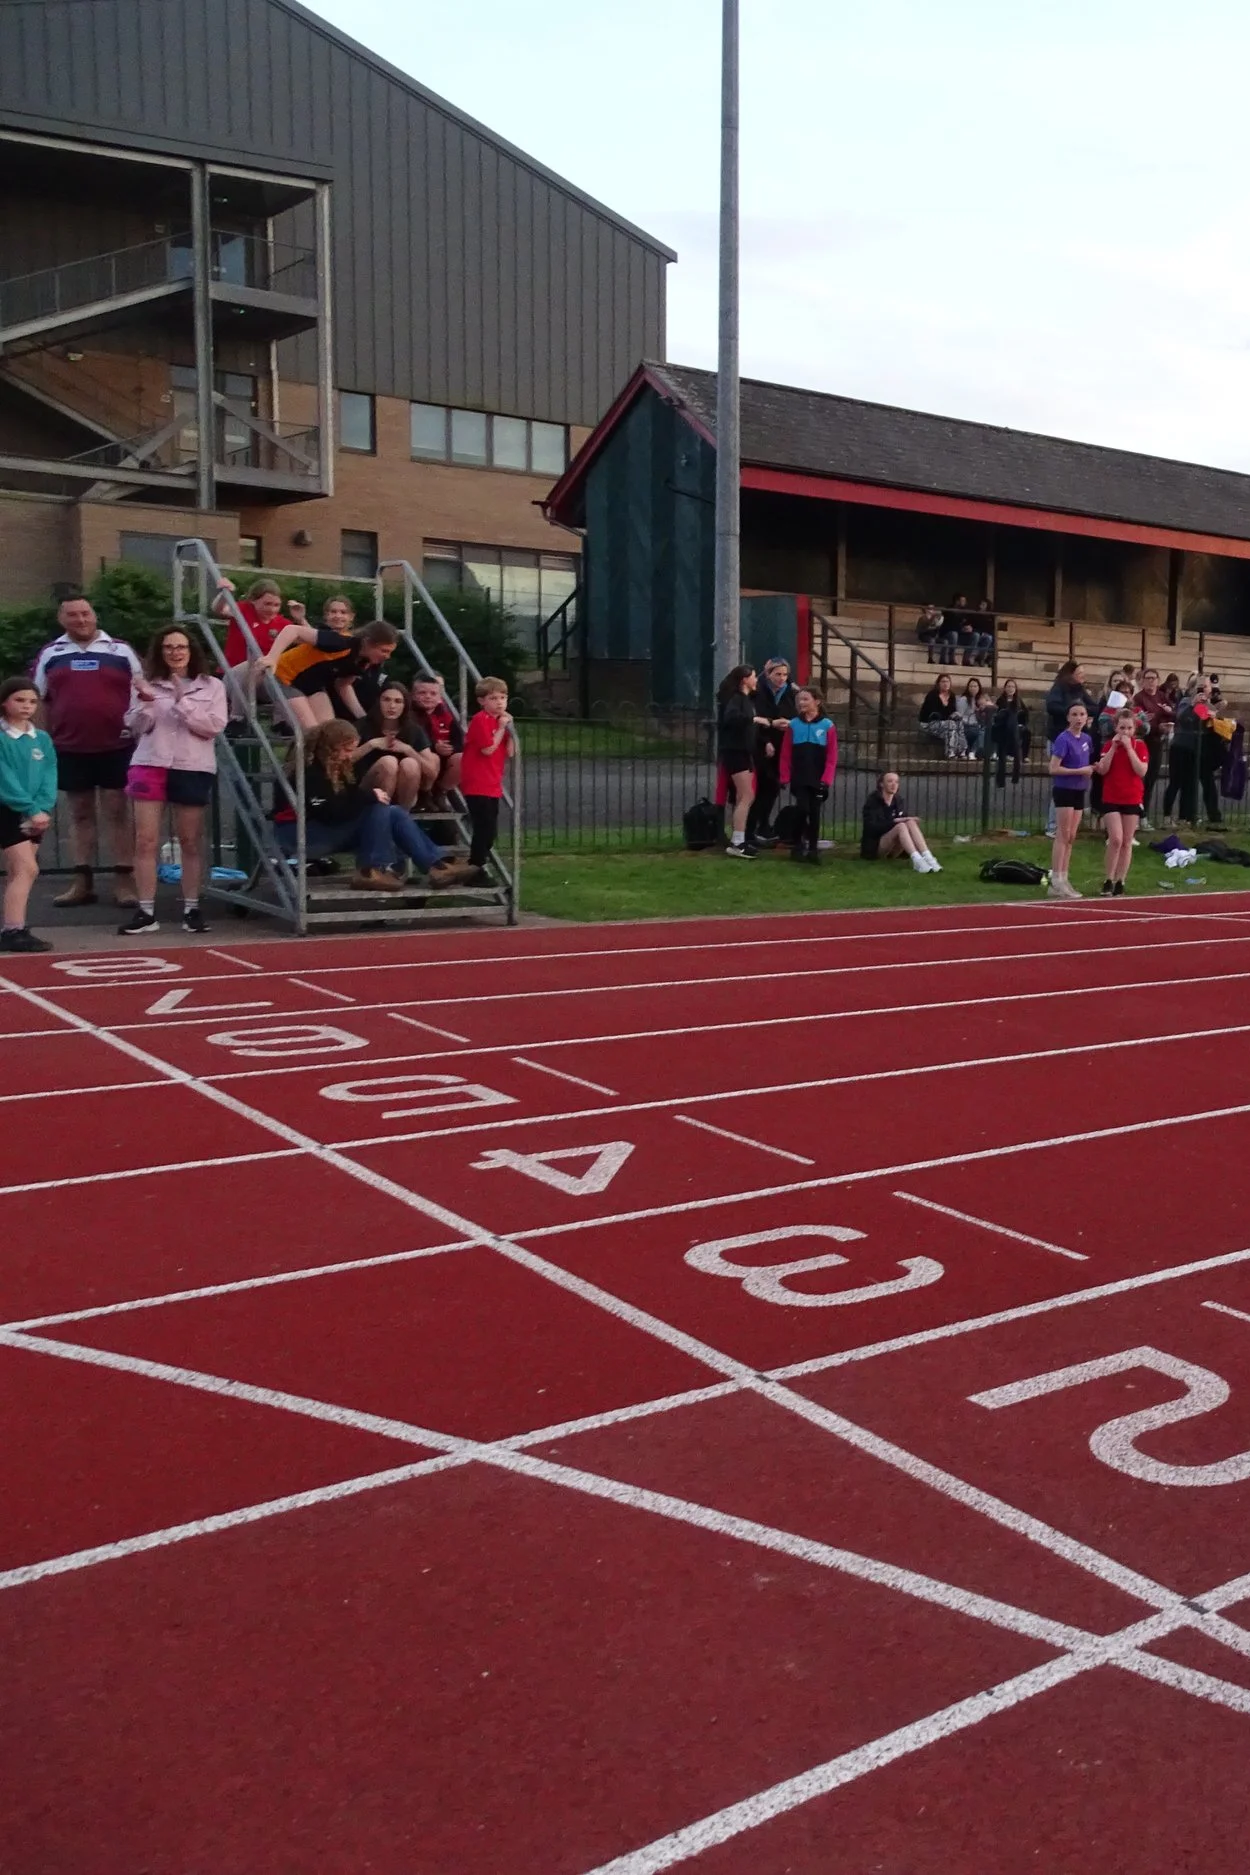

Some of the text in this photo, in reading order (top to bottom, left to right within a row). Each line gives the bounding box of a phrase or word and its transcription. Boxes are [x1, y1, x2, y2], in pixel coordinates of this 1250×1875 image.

[51, 956, 183, 978] 8
[145, 988, 274, 1015] 7
[206, 1024, 370, 1057] 6
[318, 1074, 519, 1119] 5
[469, 1140, 636, 1196] 4
[683, 1224, 945, 1307] 3
